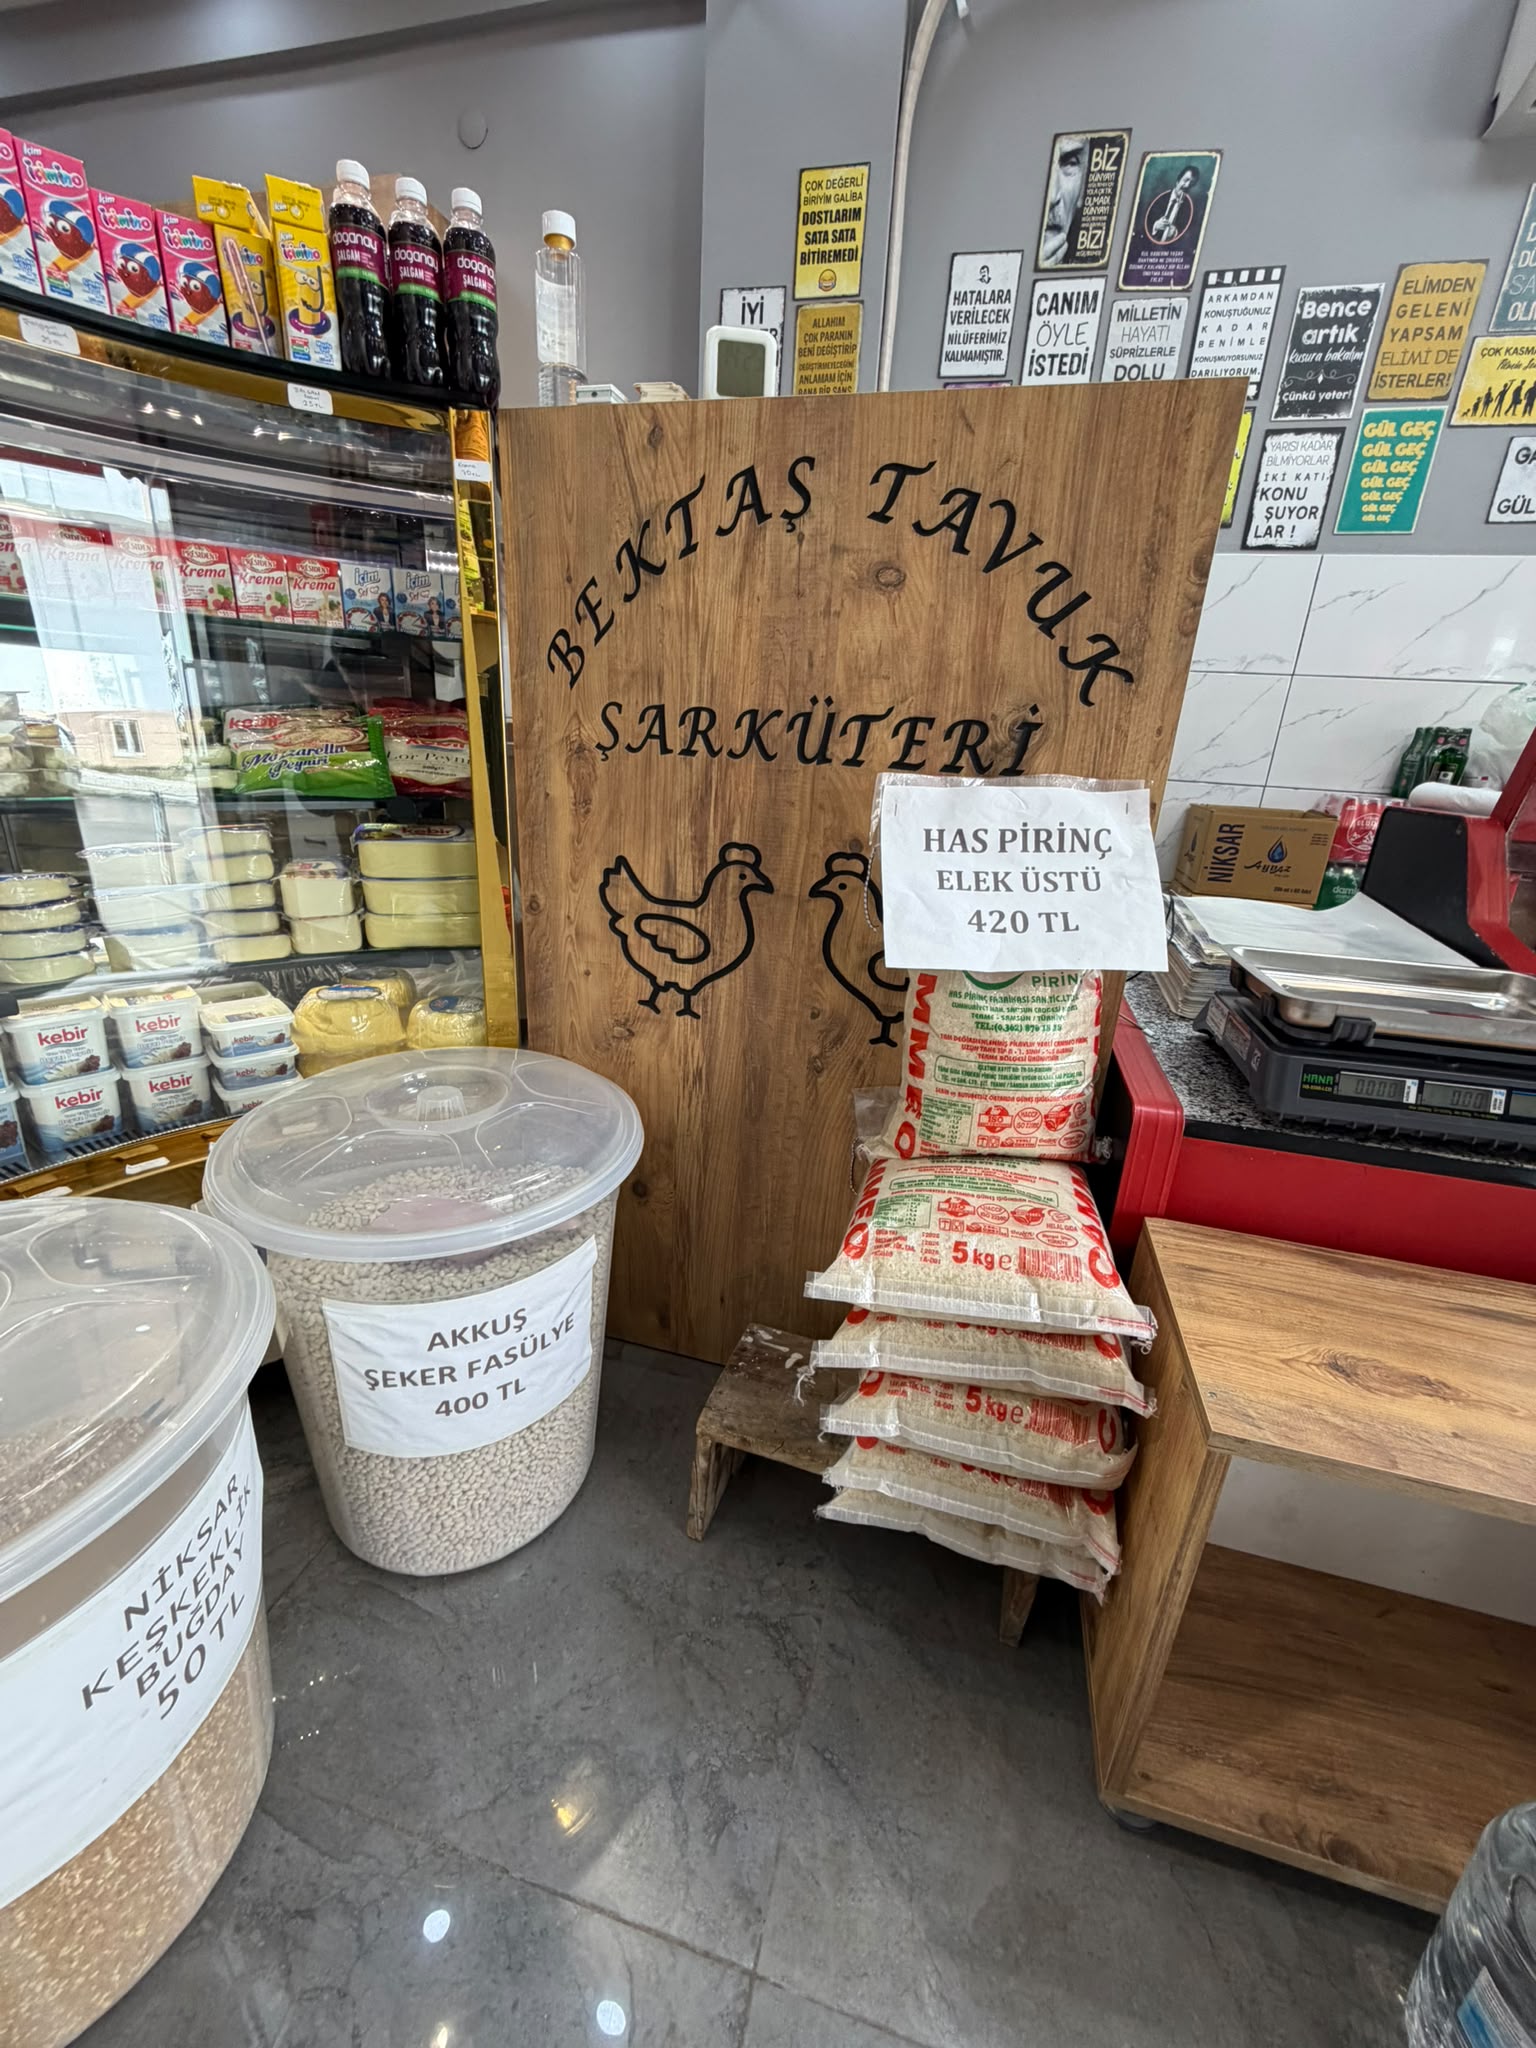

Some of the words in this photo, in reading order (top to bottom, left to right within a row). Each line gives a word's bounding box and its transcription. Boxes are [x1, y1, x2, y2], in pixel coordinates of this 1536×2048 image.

[1090, 143, 1120, 172] BİZ
[805, 180, 823, 193] ÇOK
[826, 173, 864, 190] DEĞERLİ
[804, 194, 831, 206] BİRİYİM
[834, 190, 863, 203] GALİBA
[802, 207, 861, 225] DOSTLARIM
[805, 231, 829, 245] SATA
[832, 228, 856, 243] SATA
[1077, 226, 1105, 249] BİZİ
[337, 250, 360, 262] ŞALGAM
[800, 246, 858, 265] BİTİREMEDİ
[400, 266, 424, 280] ŞALGAM
[463, 274, 486, 289] ŞALGAM
[1402, 276, 1476, 295] ELİMDEN
[953, 289, 1011, 306] HATALARA
[1036, 290, 1099, 316] CANIM
[1208, 292, 1274, 304] ARKAMDAN
[741, 296, 764, 324] İYİ
[950, 307, 1011, 325] VERİLECEK
[1117, 302, 1182, 322] MİLLETİN
[1204, 306, 1272, 318] KONUŞTUĞUNUZ
[1302, 299, 1372, 319] Bence
[1396, 298, 1471, 318] GELENİ
[812, 316, 845, 328] ALLAHIM
[1201, 322, 1268, 333] KADAR
[804, 332, 819, 345] ÇOK
[820, 330, 852, 342] PARANIN
[948, 329, 1007, 345] NİLÜFERİMİZ
[1036, 321, 1089, 347] ÖYLE
[1121, 325, 1170, 342] HAYATI
[1302, 324, 1359, 345] artık
[1390, 326, 1463, 343] YAPSAM
[799, 345, 815, 358] BENİ
[816, 342, 857, 358] DEĞİŞTİRİP
[1198, 337, 1266, 348] BENİMLE
[945, 349, 1004, 365] KALMAMIŞTIR.
[1110, 345, 1176, 359] SÜPRİZLERLE
[1194, 353, 1263, 363] KONUŞMUYORSUNUZ
[1380, 349, 1431, 366] ELİMİ
[1435, 350, 1459, 364] DE
[1481, 347, 1503, 359] ÇOK
[1028, 347, 1089, 376] İSTEDİ
[800, 373, 835, 384] ANLAMAM
[837, 370, 852, 388] İÇİN
[1114, 363, 1165, 381] DOLU
[1191, 367, 1261, 377] DARILIYORUM.
[1374, 371, 1451, 388] İSTERLER!
[1282, 390, 1315, 404] çünkü
[1319, 390, 1352, 405] yeter!
[1364, 420, 1396, 438] GÜL
[1401, 421, 1437, 441] GEÇ
[1270, 441, 1299, 452] YARISI
[1301, 440, 1334, 451] KADAR
[1362, 442, 1392, 457] GÜL
[1395, 442, 1428, 460] GEÇ
[1266, 455, 1330, 466] BİLMİYORLAR
[1361, 460, 1388, 474] GÜL
[1390, 460, 1419, 476] GEÇ
[1264, 472, 1287, 482] İKİ
[1361, 476, 1384, 488] GÜL
[1386, 477, 1411, 490] GEÇ
[1260, 487, 1308, 501] KONU
[1361, 491, 1380, 502] GÜL
[1383, 492, 1404, 503] GEÇ
[1265, 506, 1319, 523] ŞUYOR
[1254, 525, 1285, 538] LAR
[1290, 525, 1296, 538] !
[114, 556, 164, 570] Krema
[179, 565, 226, 578] Krema
[239, 572, 283, 585] Krema
[293, 578, 336, 590] Krema
[547, 456, 816, 690] BEKTAŞ
[866, 460, 1134, 707] TAVUK
[595, 695, 1044, 776] ŞARKÜTERİ
[241, 744, 346, 770] Mozzarella
[387, 752, 418, 760] Lor
[269, 756, 328, 779] Peyniri
[923, 828, 988, 854] HAS
[998, 821, 1112, 860] PİRİNÇ
[1204, 824, 1245, 882] NİKSAR
[937, 870, 1014, 892] ELEK
[1020, 867, 1101, 892] ÜSTÜ
[968, 909, 1029, 934] 420
[1038, 912, 1080, 933] TL
[1032, 972, 1082, 988] PİRİN
[136, 1015, 181, 1034] kebir
[38, 1026, 88, 1046] kebir
[233, 1034, 254, 1044] kebir
[236, 1068, 257, 1078] kebir
[1304, 1073, 1334, 1085] HANA
[149, 1074, 193, 1093] kebir
[55, 1089, 103, 1110] kebir
[988, 1115, 1004, 1123] ISO
[952, 1241, 968, 1264] 5
[973, 1248, 995, 1271] kg
[427, 1308, 527, 1352] AKKUŞ
[364, 1366, 457, 1391] ŞEKER
[467, 1312, 575, 1379] FASÜLYE
[434, 1392, 489, 1417] 400
[496, 1378, 526, 1401] TL
[966, 1386, 982, 1413] 5
[985, 1396, 1007, 1421] kg
[124, 1474, 238, 1632] NİKSAR
[81, 1475, 251, 1711] KEŞKEKLİK
[136, 1532, 245, 1699] BUĞDAY
[158, 1644, 206, 1720] 50
[210, 1592, 245, 1642] TL
